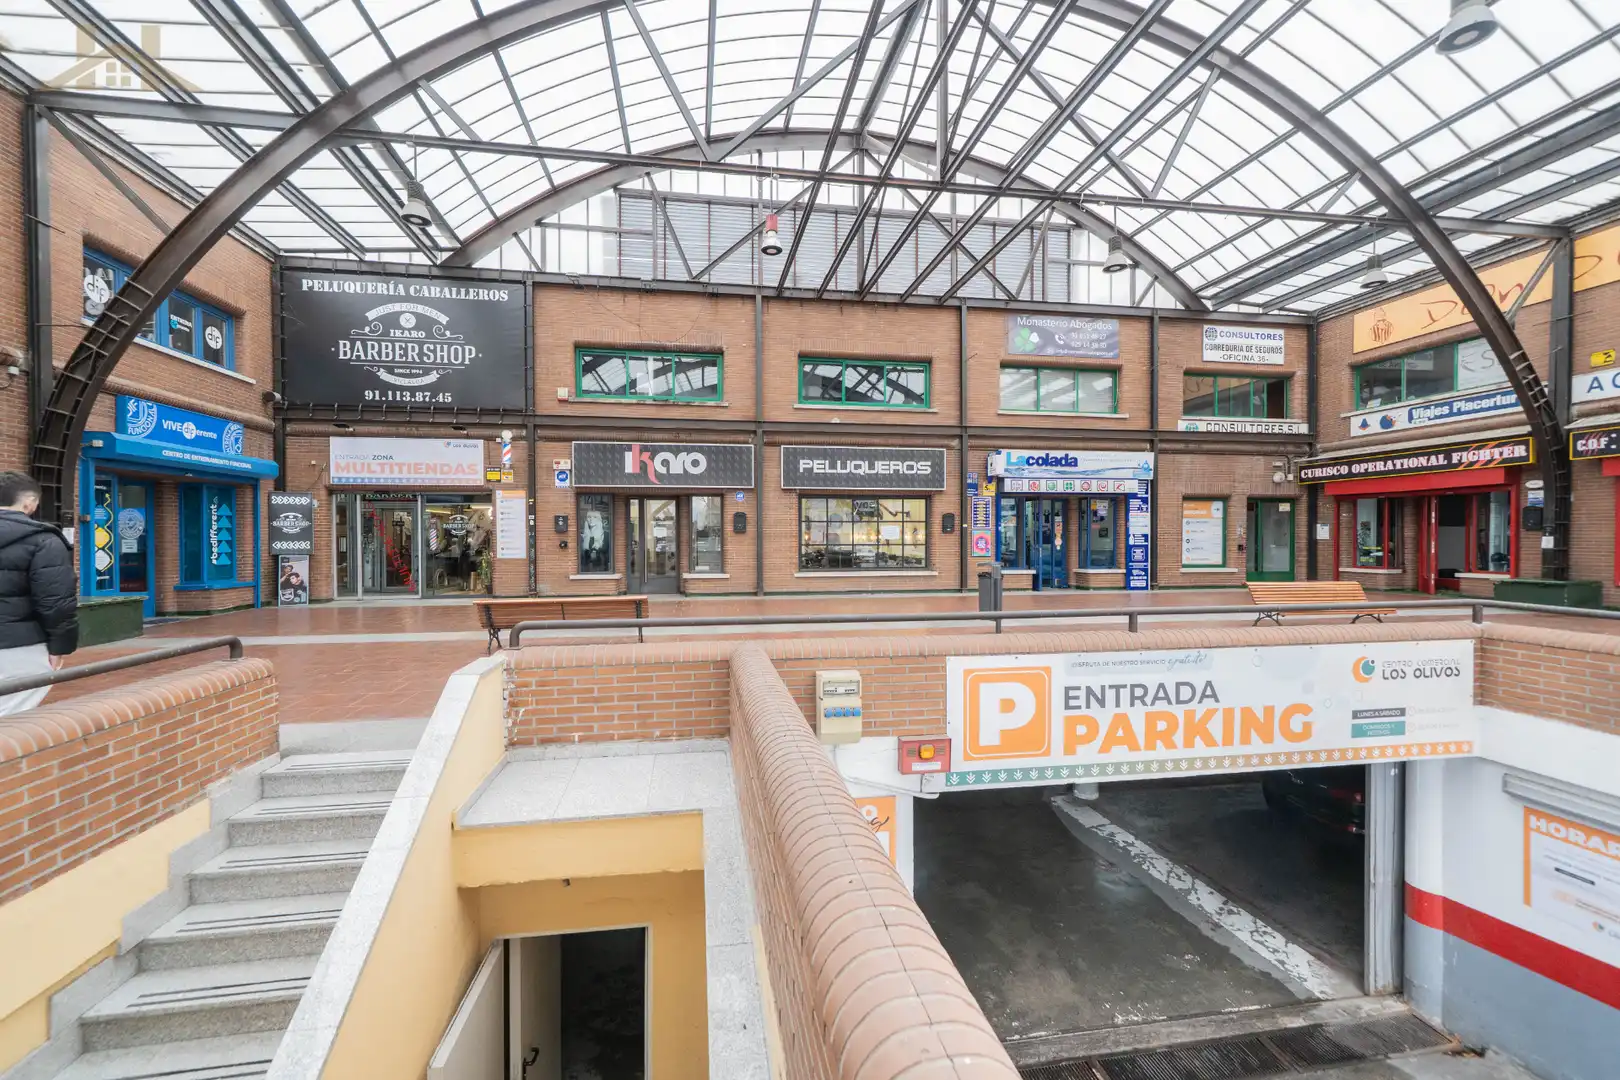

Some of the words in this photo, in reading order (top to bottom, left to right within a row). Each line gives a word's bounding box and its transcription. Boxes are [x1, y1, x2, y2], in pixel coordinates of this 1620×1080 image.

[301, 278, 406, 296] PELUQUERÍA
[409, 284, 509, 302] CABALLEROS
[375, 304, 398, 317] JUST
[399, 303, 419, 312] FOR
[421, 307, 441, 320] MEN
[1017, 316, 1068, 328] Monasterio
[1069, 319, 1113, 331] Abogados
[389, 328, 426, 339] IKARO
[1219, 330, 1284, 342] CONSULTORES
[337, 340, 421, 363] BARBER
[422, 343, 476, 365] SHOP
[1204, 343, 1244, 352] CORREDURIA
[1245, 345, 1253, 353] DE
[1254, 346, 1283, 355] SEGUROS
[364, 389, 453, 403] 91.113.87.45
[1411, 405, 1450, 421] Viajes
[1452, 394, 1517, 413] Placertur
[162, 449, 184, 459] CENTRO
[1300, 464, 1349, 479] CURISCO
[1351, 453, 1448, 475] OPERATIONAL
[1451, 444, 1528, 465] FIGHTER
[334, 460, 480, 476] MULTITIENDAS
[799, 459, 932, 476] PELUQUEROS
[1102, 659, 1110, 667] DE
[1111, 659, 1138, 667] NUESTRO
[1138, 658, 1166, 666] SERVICIO
[1382, 660, 1413, 669] CENTRO
[1416, 658, 1461, 668] COMERCIAL
[1382, 667, 1407, 681] LOS
[1413, 666, 1461, 679] OLIVOS
[1063, 680, 1221, 711] ENTRADA
[978, 681, 1037, 747] P
[1062, 703, 1314, 756] PARKING
